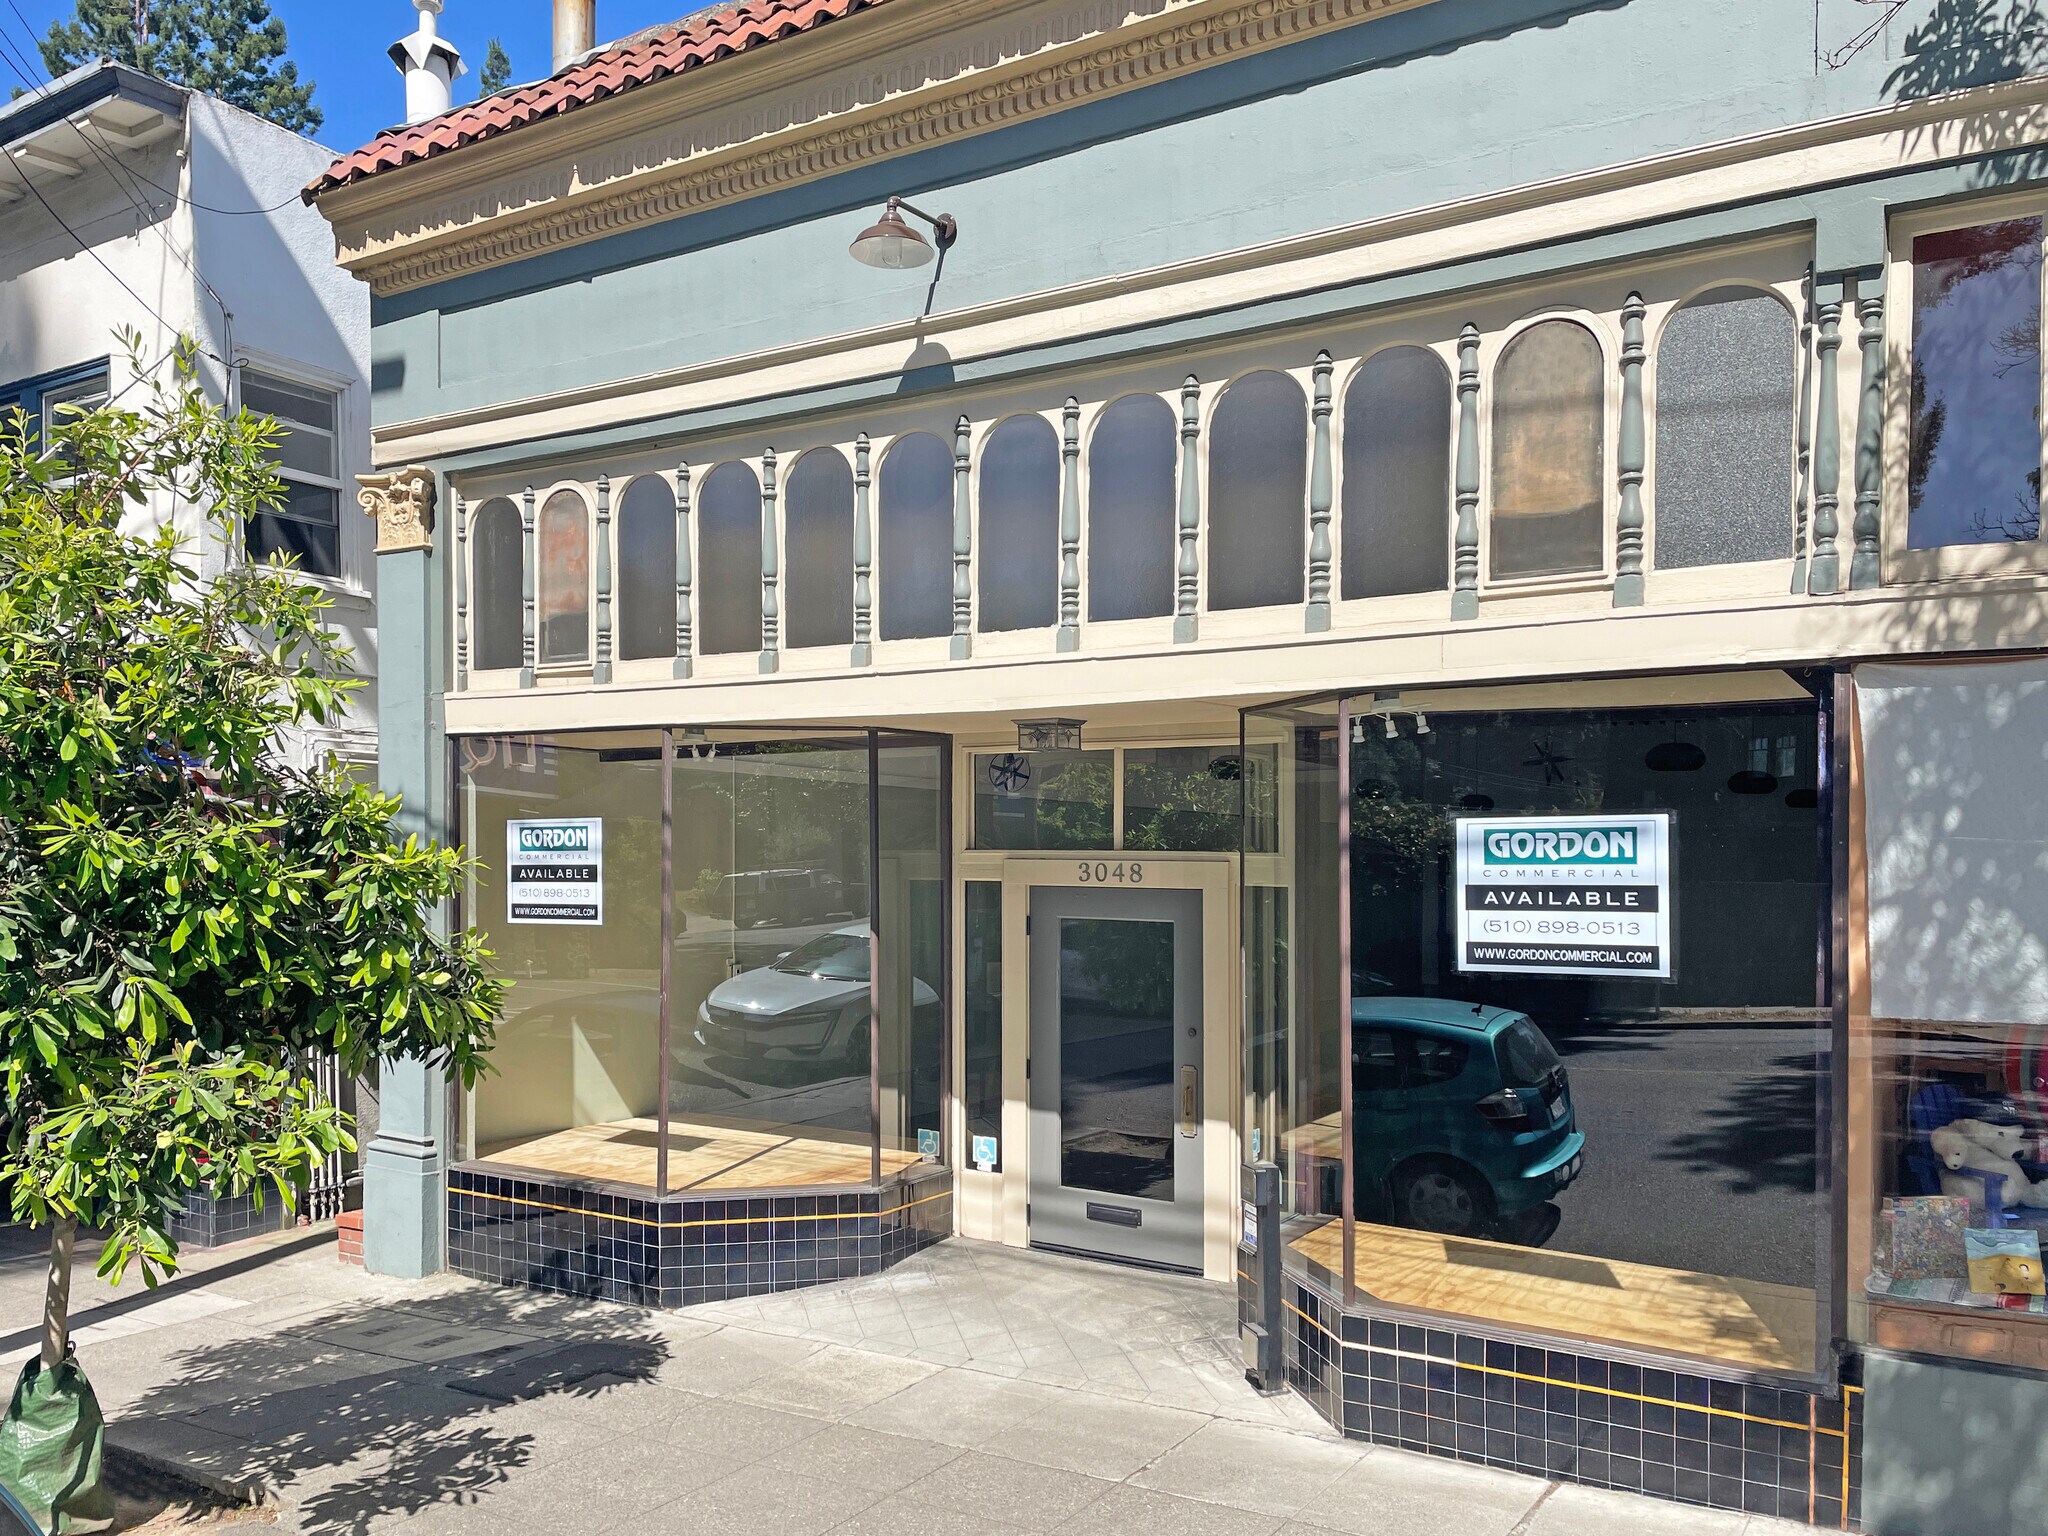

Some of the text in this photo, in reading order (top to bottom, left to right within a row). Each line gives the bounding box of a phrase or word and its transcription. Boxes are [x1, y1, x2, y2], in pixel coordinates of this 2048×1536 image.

[521, 828, 587, 848] GORDON
[1488, 831, 1634, 861] GORDON
[519, 868, 589, 879] AVAILABLE
[1078, 862, 1143, 883] 3048
[1483, 869, 1639, 878] COMMERCIAL
[519, 888, 590, 898] (510) 898-0513
[1484, 891, 1640, 906] AVAILABLE
[514, 907, 595, 917] WWW.GORDONCOMMERCIAL.COM
[1483, 918, 1640, 936] (510) 898-0513
[1473, 947, 1652, 964] WWW.GORDONCOMMERCIAL.COM
